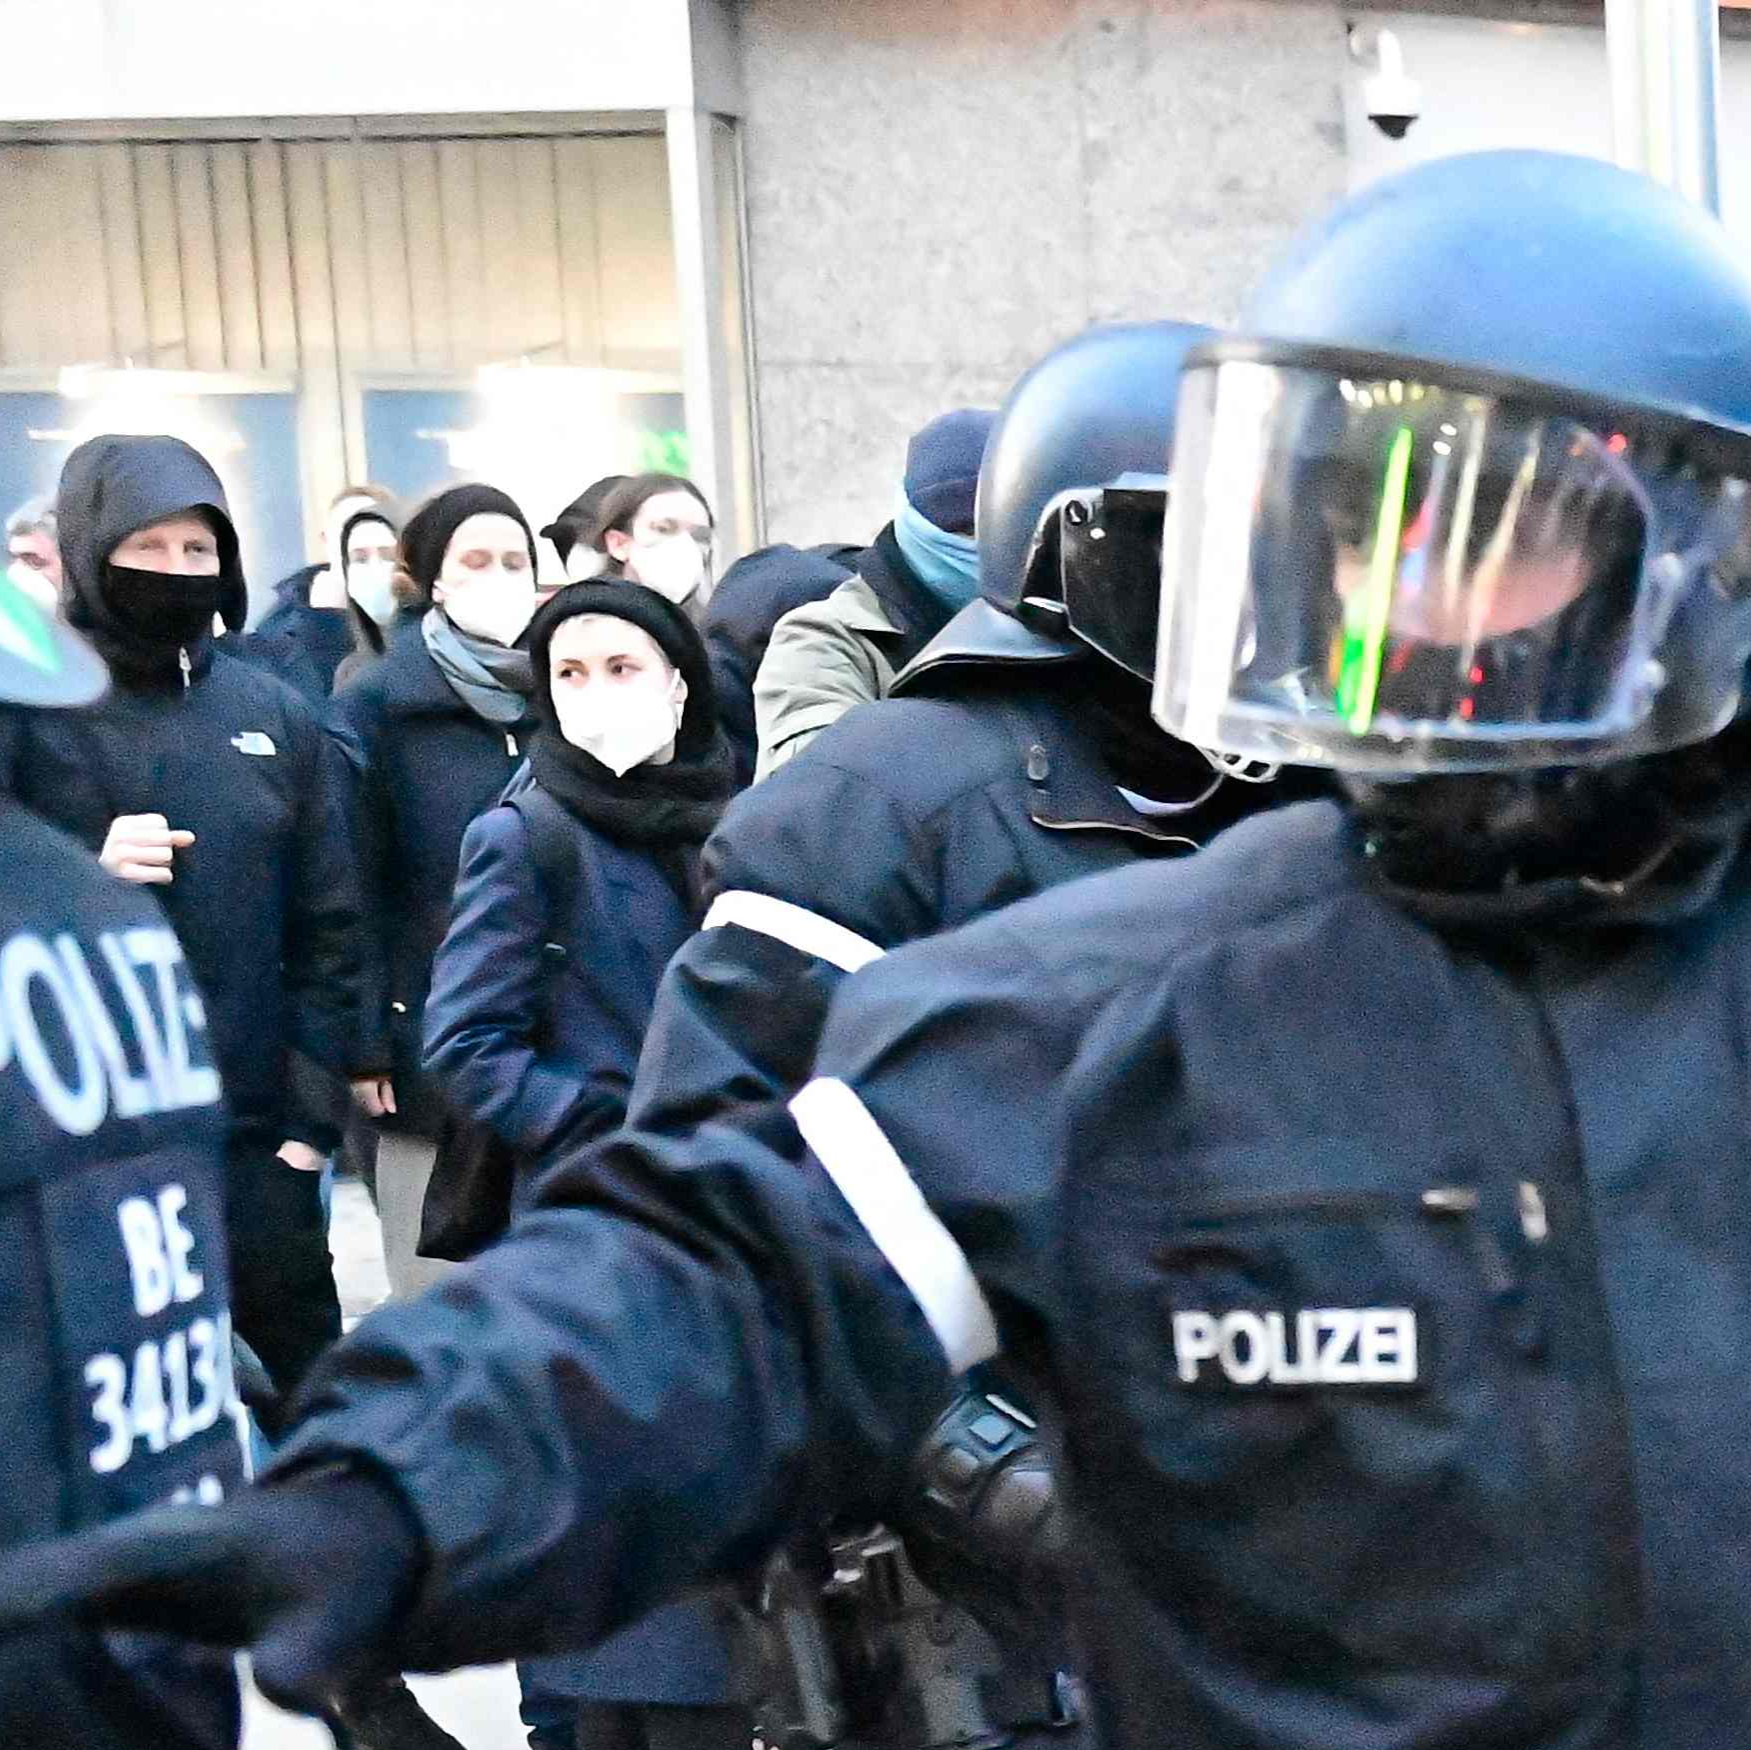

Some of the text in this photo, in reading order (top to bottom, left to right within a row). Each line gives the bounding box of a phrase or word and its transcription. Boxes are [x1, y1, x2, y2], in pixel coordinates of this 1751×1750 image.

[0, 929, 224, 1136] OLIZ
[117, 1183, 205, 1318] BE
[1172, 1306, 1419, 1384] POLIZEI
